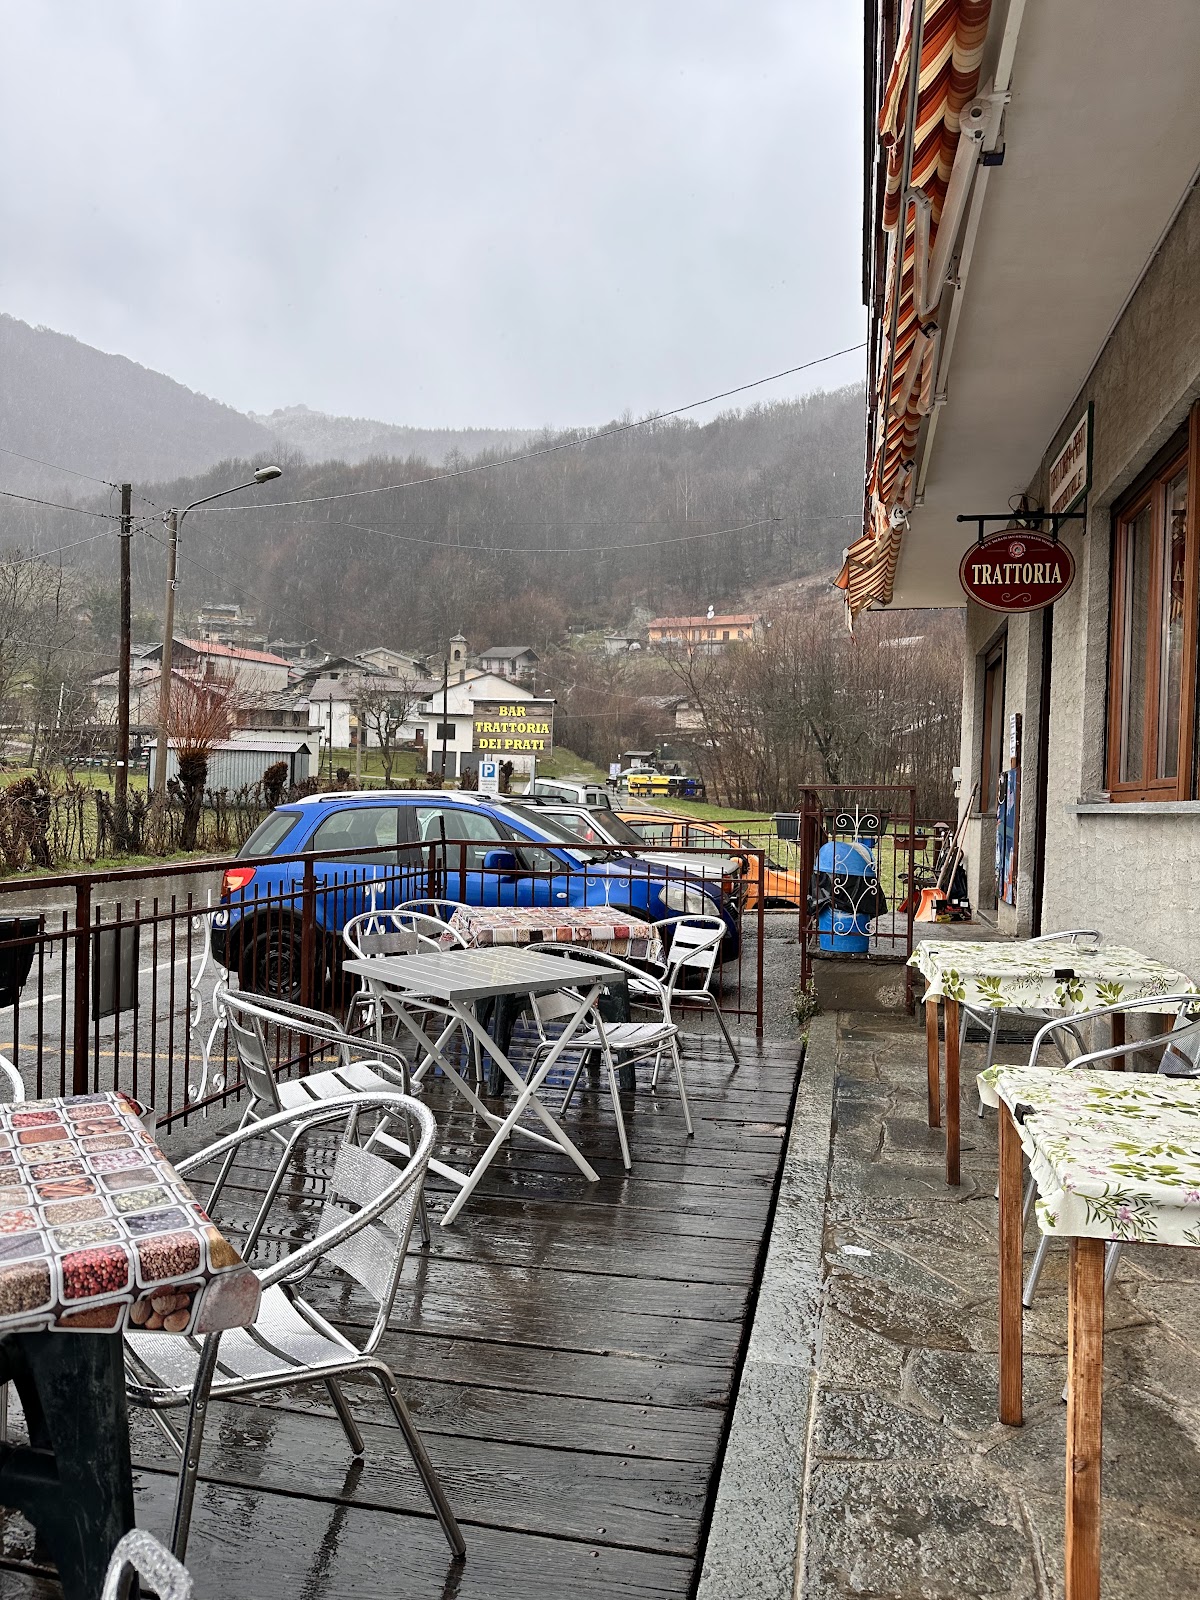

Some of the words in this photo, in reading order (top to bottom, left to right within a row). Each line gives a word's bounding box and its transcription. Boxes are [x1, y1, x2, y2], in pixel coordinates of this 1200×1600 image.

[972, 562, 1062, 585] TRATTORIA
[499, 706, 526, 717] BAR
[475, 722, 549, 734] TRATTORIA
[479, 738, 502, 749] DEI
[505, 739, 544, 750] PRATI
[484, 764, 494, 777] P
